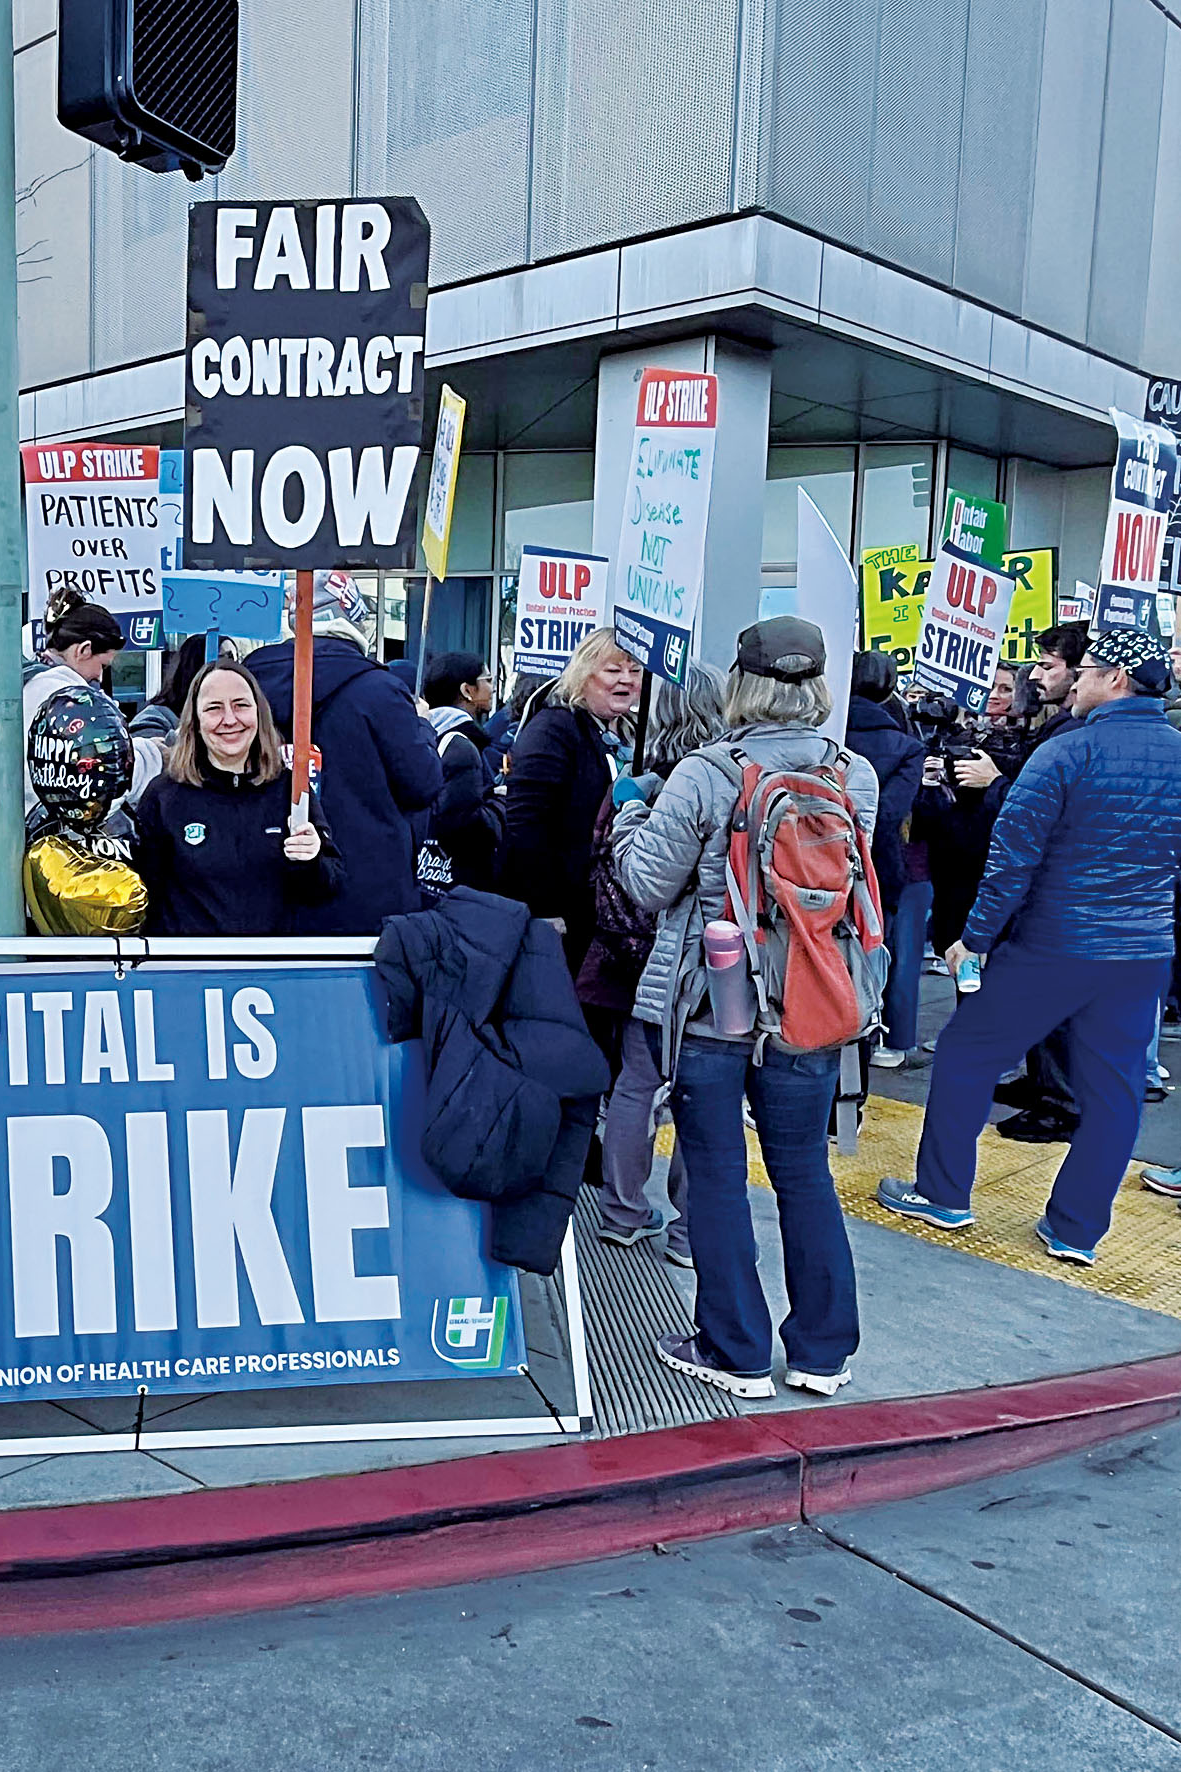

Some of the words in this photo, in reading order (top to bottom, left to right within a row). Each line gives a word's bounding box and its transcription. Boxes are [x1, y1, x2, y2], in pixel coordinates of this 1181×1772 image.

[217, 203, 392, 292] FAIR
[192, 335, 423, 398] CONTRACT
[644, 381, 666, 421] ULP
[666, 379, 708, 422] STRIKE
[38, 450, 76, 479] ULP
[81, 449, 144, 477] STRIKE
[40, 493, 158, 528] PATIENTS
[192, 445, 420, 549] NOW
[72, 538, 128, 560] OVER
[641, 530, 672, 567] NOT
[865, 544, 917, 569] THE
[1112, 513, 1161, 582] NOW
[46, 568, 157, 598] PROFITS
[539, 561, 591, 601] ULP
[627, 565, 684, 618] UNIONS
[946, 562, 997, 618] ULP
[922, 623, 993, 682] STRIKE
[35, 735, 74, 763] HAPPY
[204, 986, 279, 1081] IS
[57, 1363, 85, 1384] OF
[89, 1359, 171, 1382] HEALTH
[174, 1355, 230, 1377] CARE
[234, 1347, 401, 1374] PROFESSIONALS
